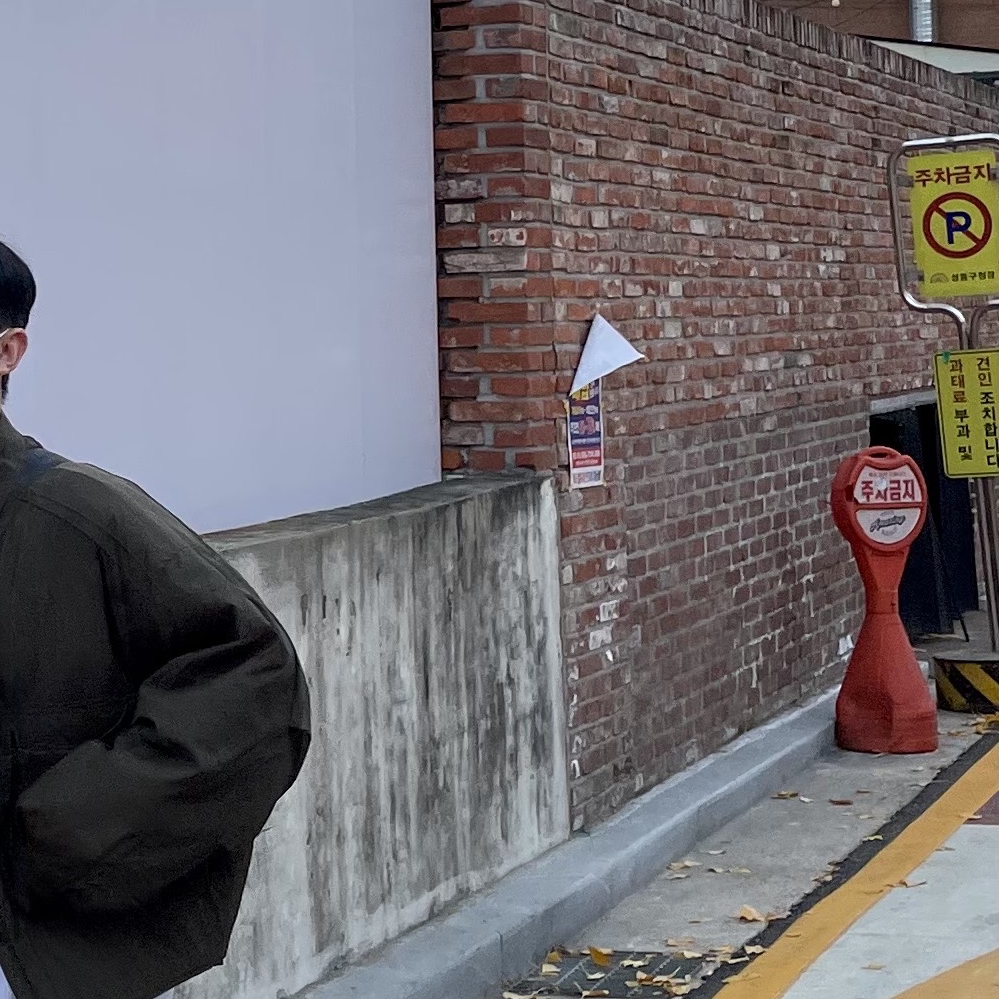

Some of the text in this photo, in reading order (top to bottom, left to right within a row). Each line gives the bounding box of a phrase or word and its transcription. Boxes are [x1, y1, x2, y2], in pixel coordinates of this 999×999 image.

[914, 163, 992, 187] 주차금지
[945, 211, 972, 244] P
[949, 358, 973, 461] 과태료 부과 및
[976, 356, 999, 468] 견인 조치합니다
